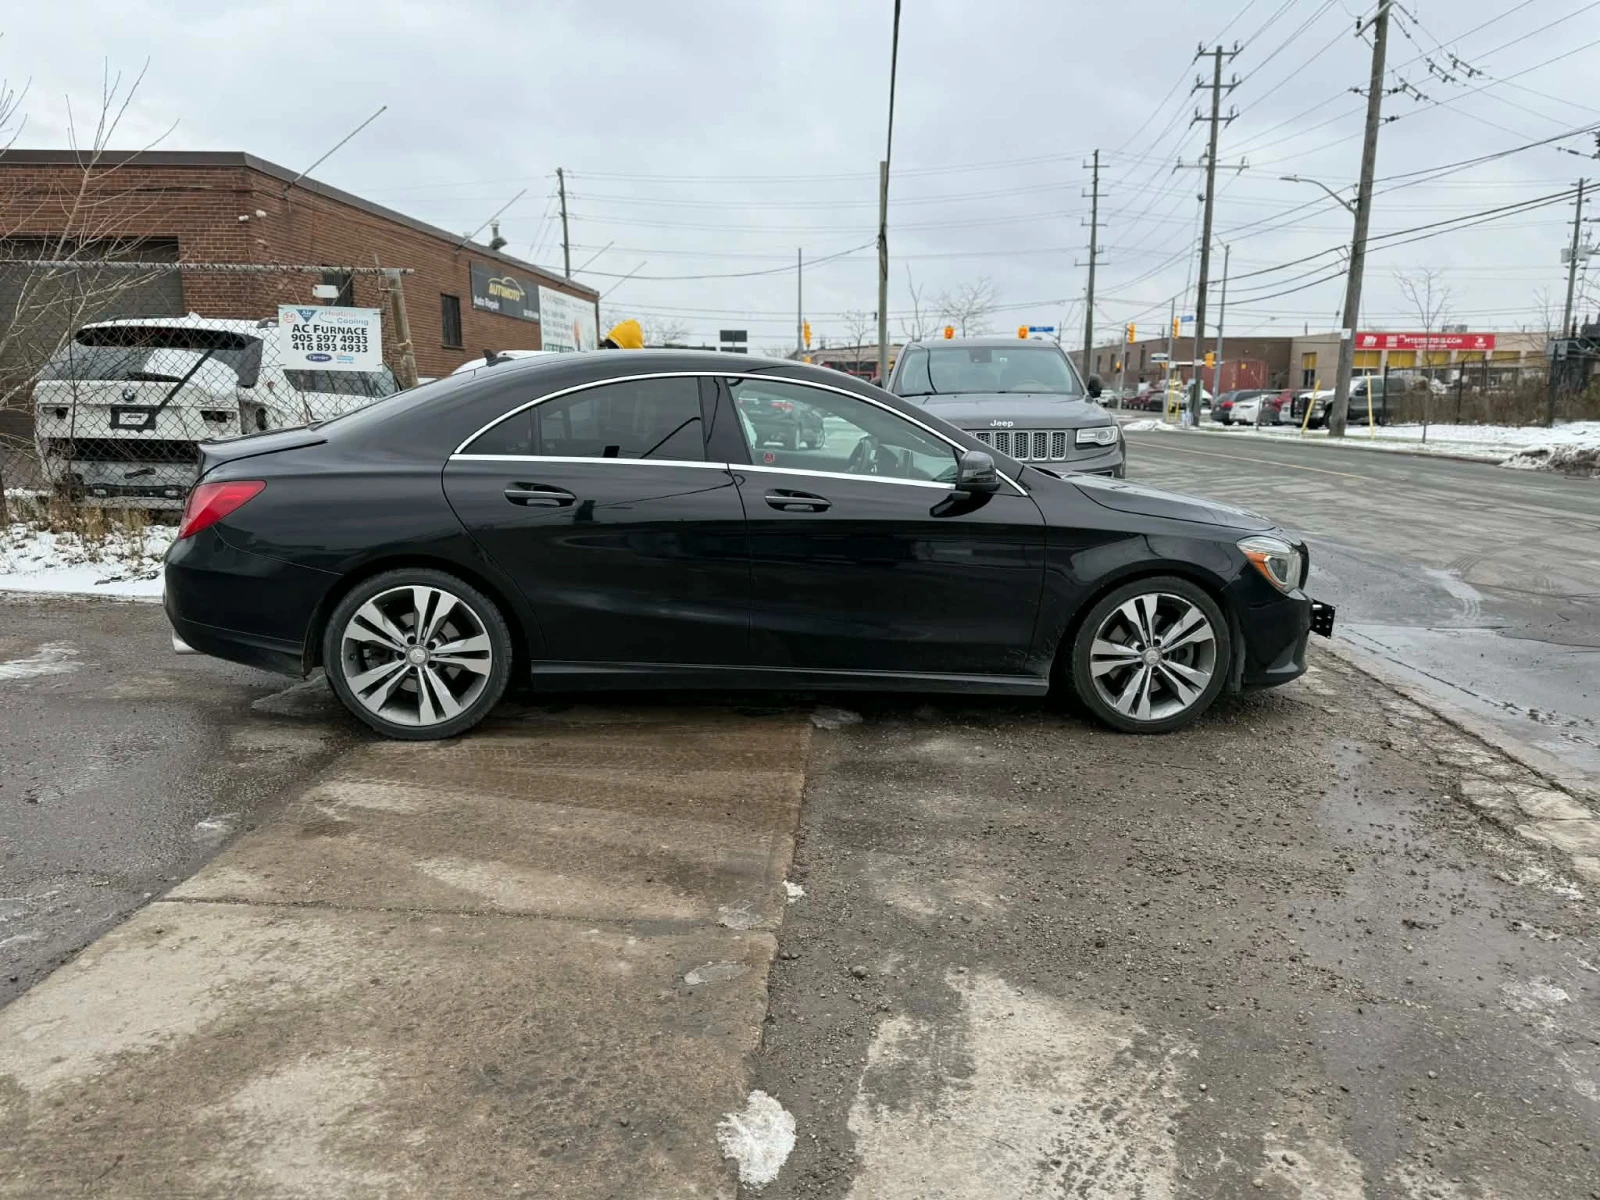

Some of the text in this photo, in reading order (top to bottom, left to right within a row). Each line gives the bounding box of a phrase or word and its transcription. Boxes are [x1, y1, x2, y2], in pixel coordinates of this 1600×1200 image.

[337, 317, 369, 326] Cooling
[292, 324, 368, 335] AC FURNACE
[291, 334, 368, 344] 905 597 4933
[293, 342, 368, 353] 416 893 4933
[990, 419, 1014, 428] Jeep
